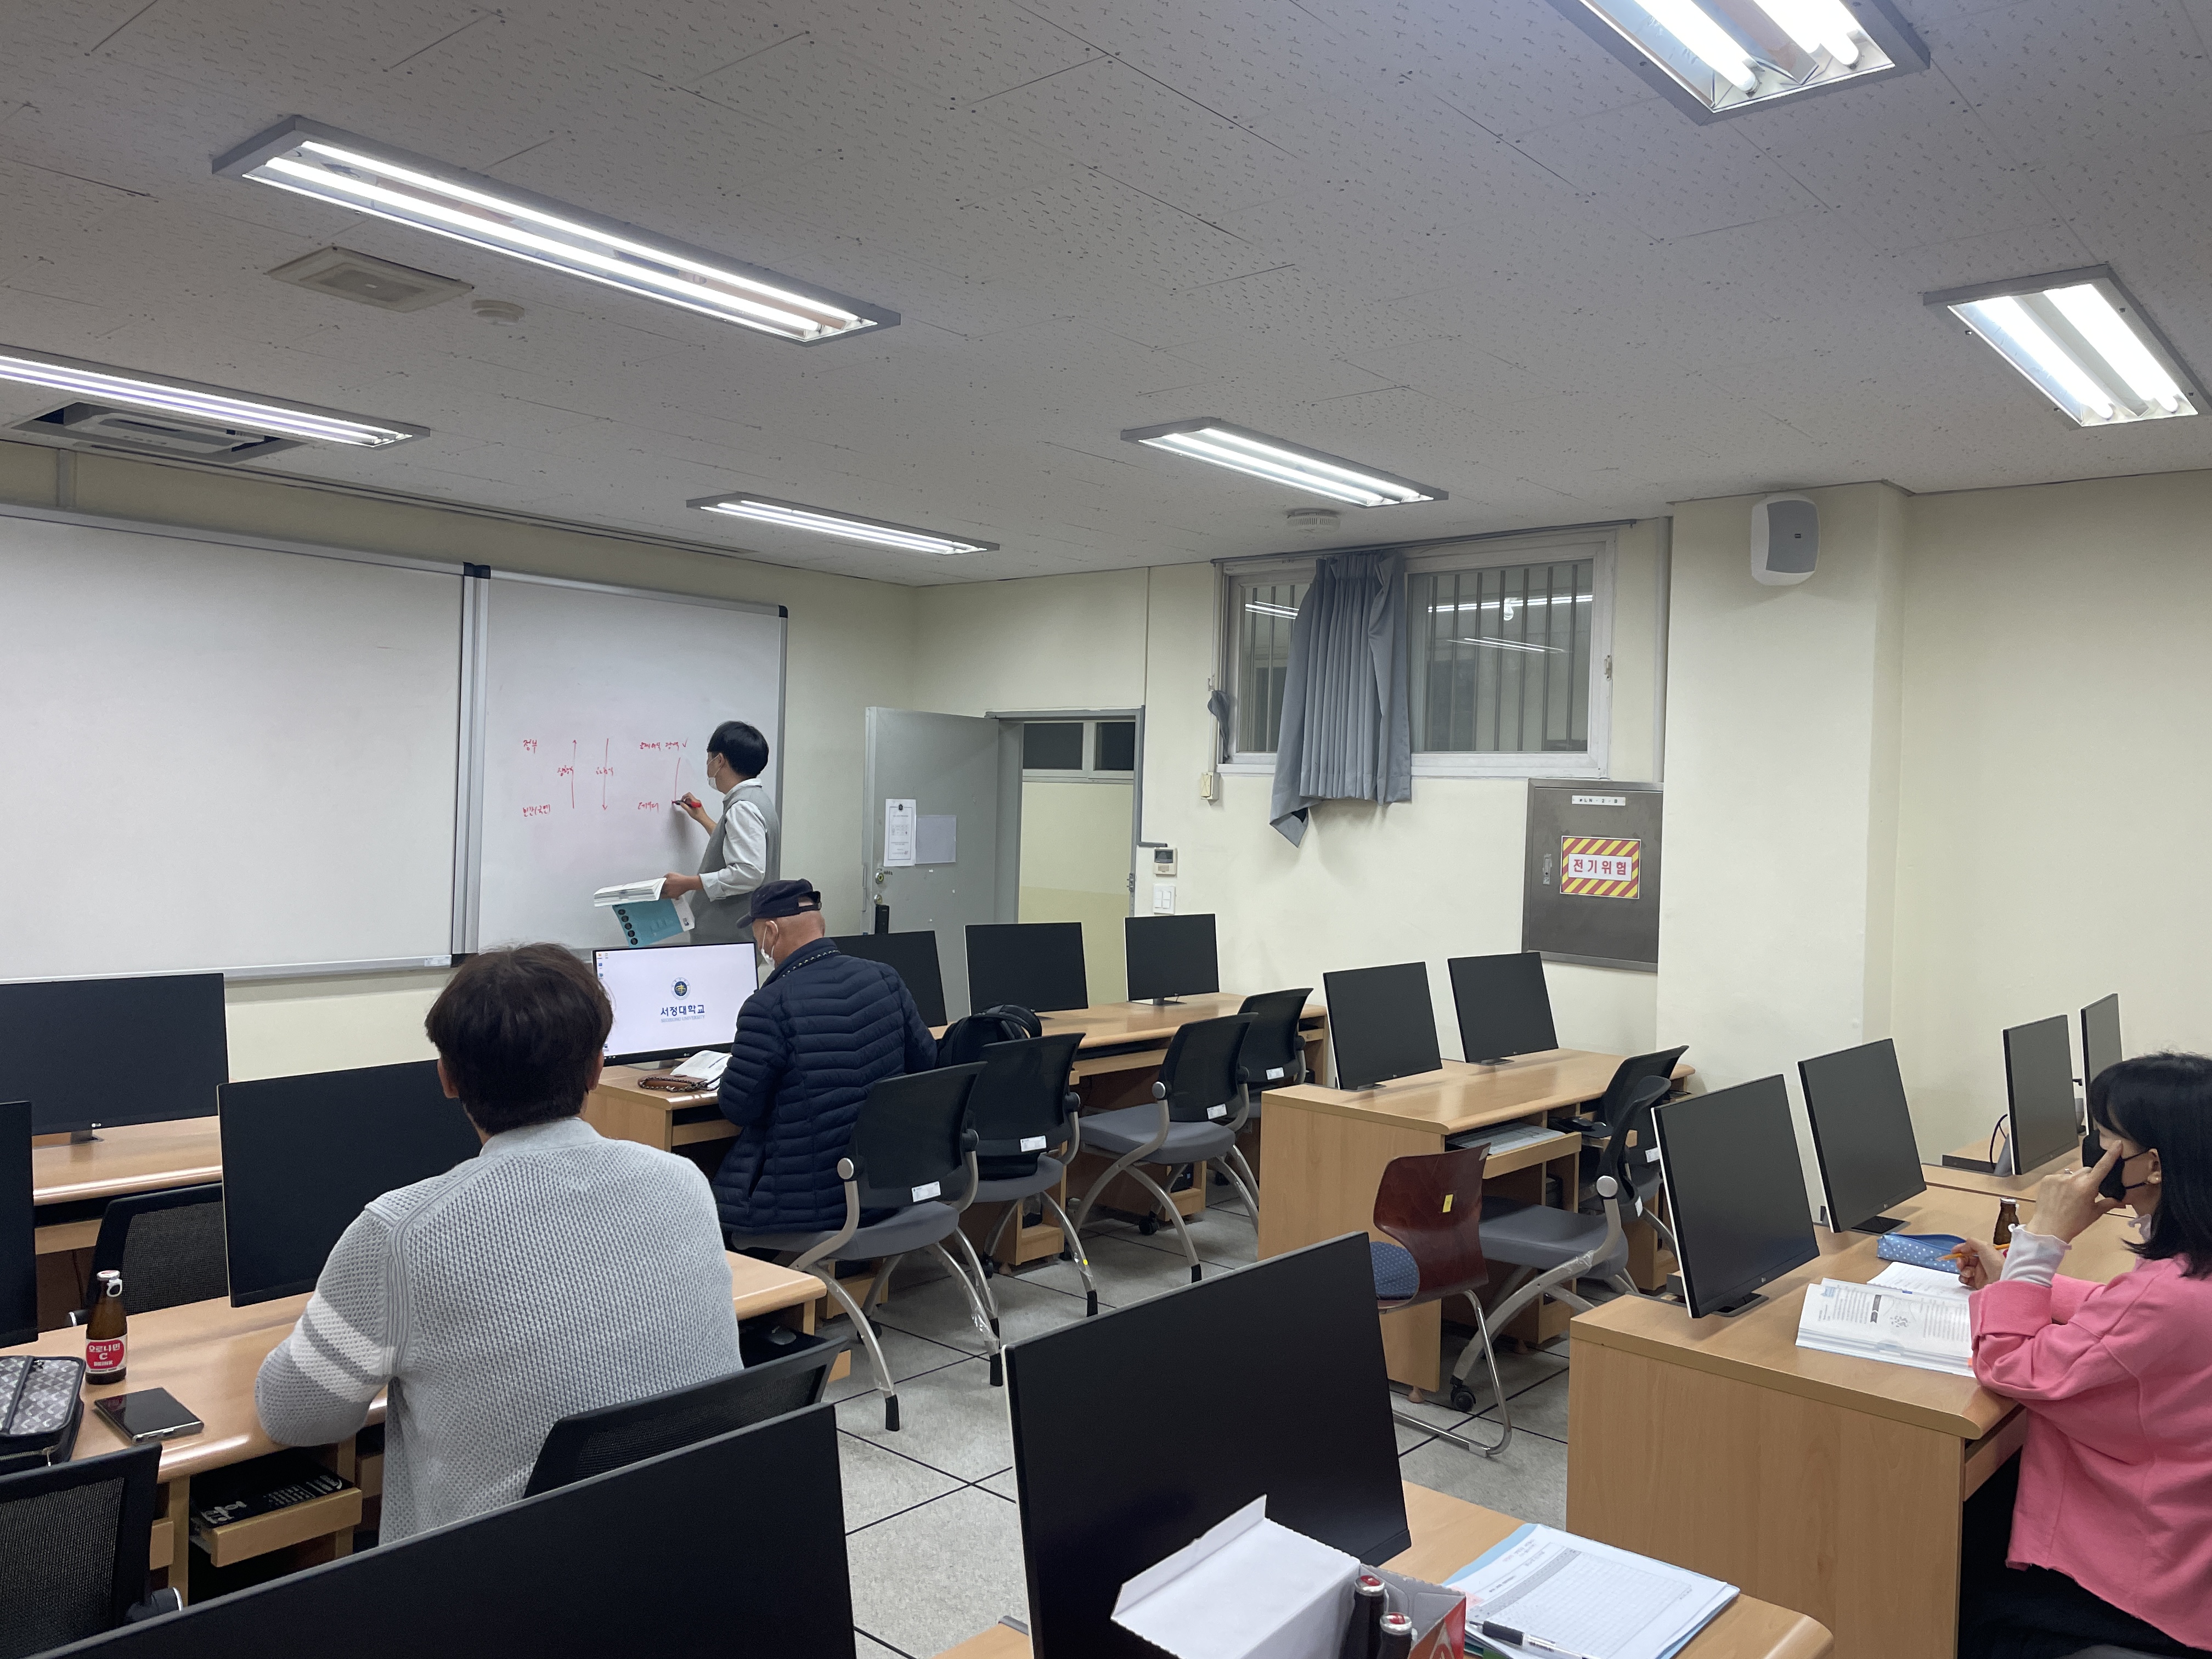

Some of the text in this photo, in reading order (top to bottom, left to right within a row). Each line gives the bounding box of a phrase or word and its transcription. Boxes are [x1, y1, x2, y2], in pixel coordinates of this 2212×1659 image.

[523, 739, 538, 754] 정부
[1573, 859, 1626, 875] 전기위험
[661, 1005, 705, 1017] 서정대학교
[89, 1342, 120, 1353] 오로나민
